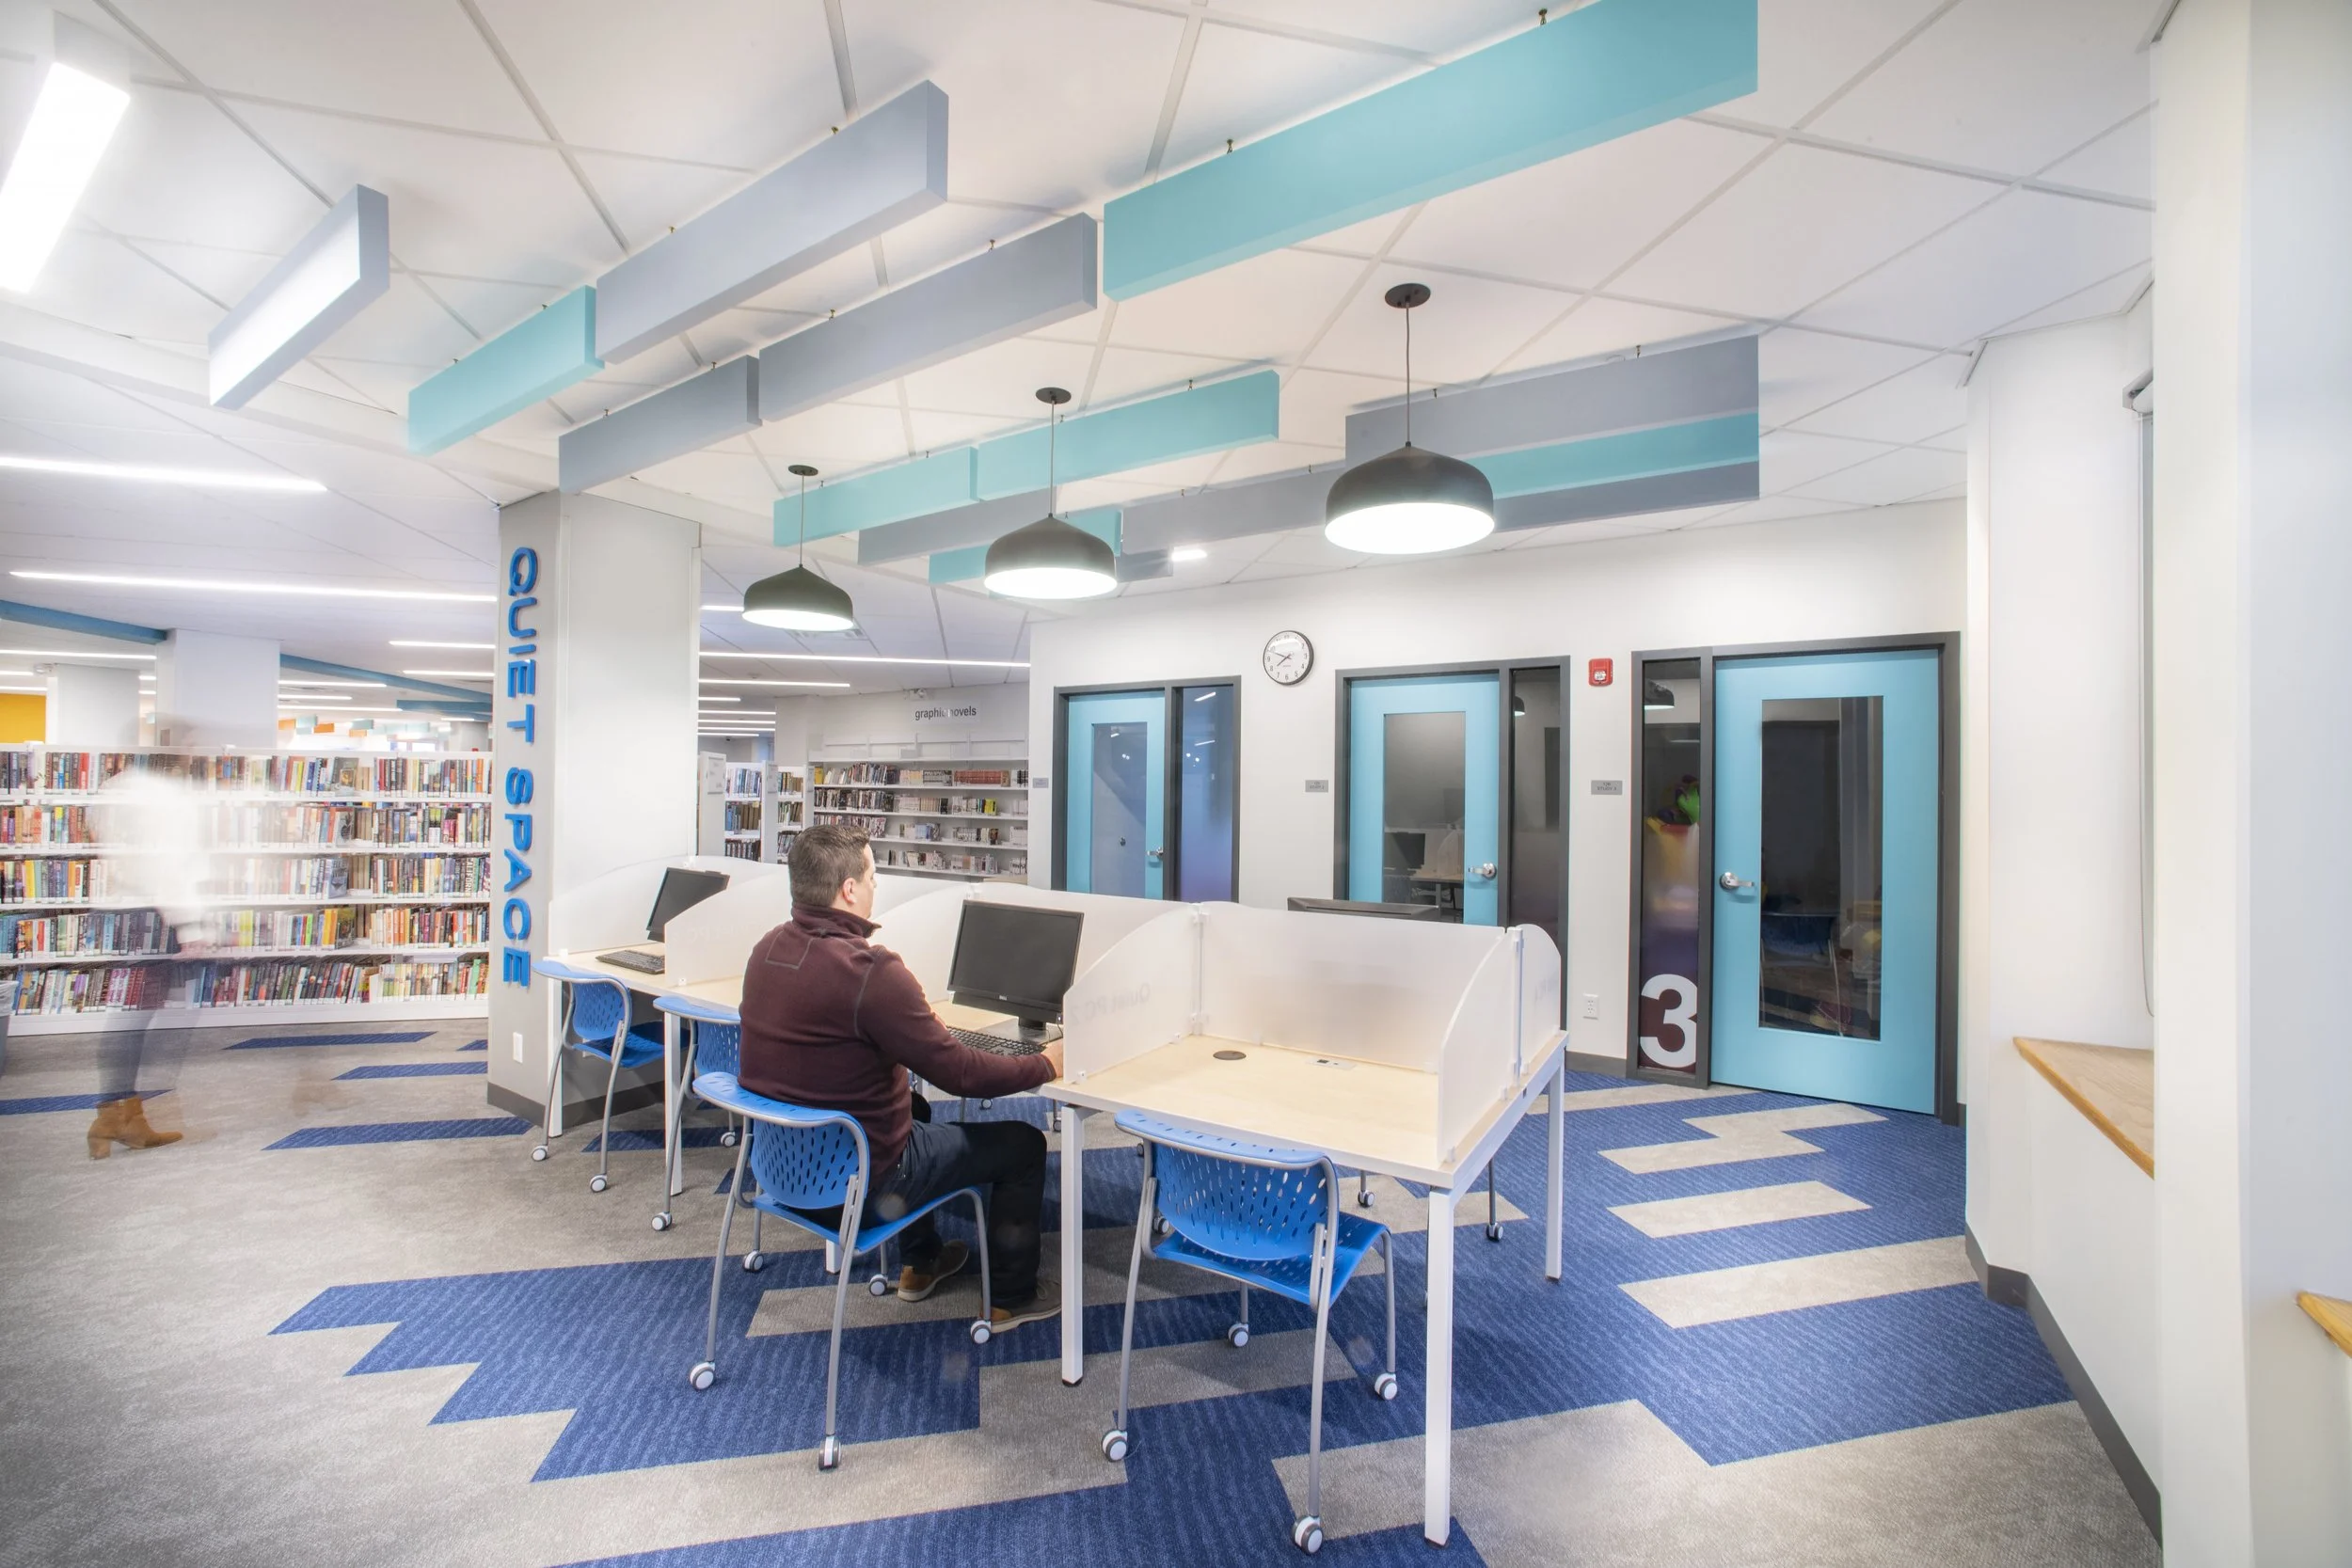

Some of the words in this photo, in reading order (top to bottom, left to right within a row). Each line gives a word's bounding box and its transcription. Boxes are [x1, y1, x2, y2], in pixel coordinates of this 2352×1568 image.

[507, 546, 538, 744] QUIET
[914, 707, 946, 721] graphic
[947, 705, 977, 718] novels
[502, 767, 533, 988] SPACE
[1640, 974, 1697, 1068] 3
